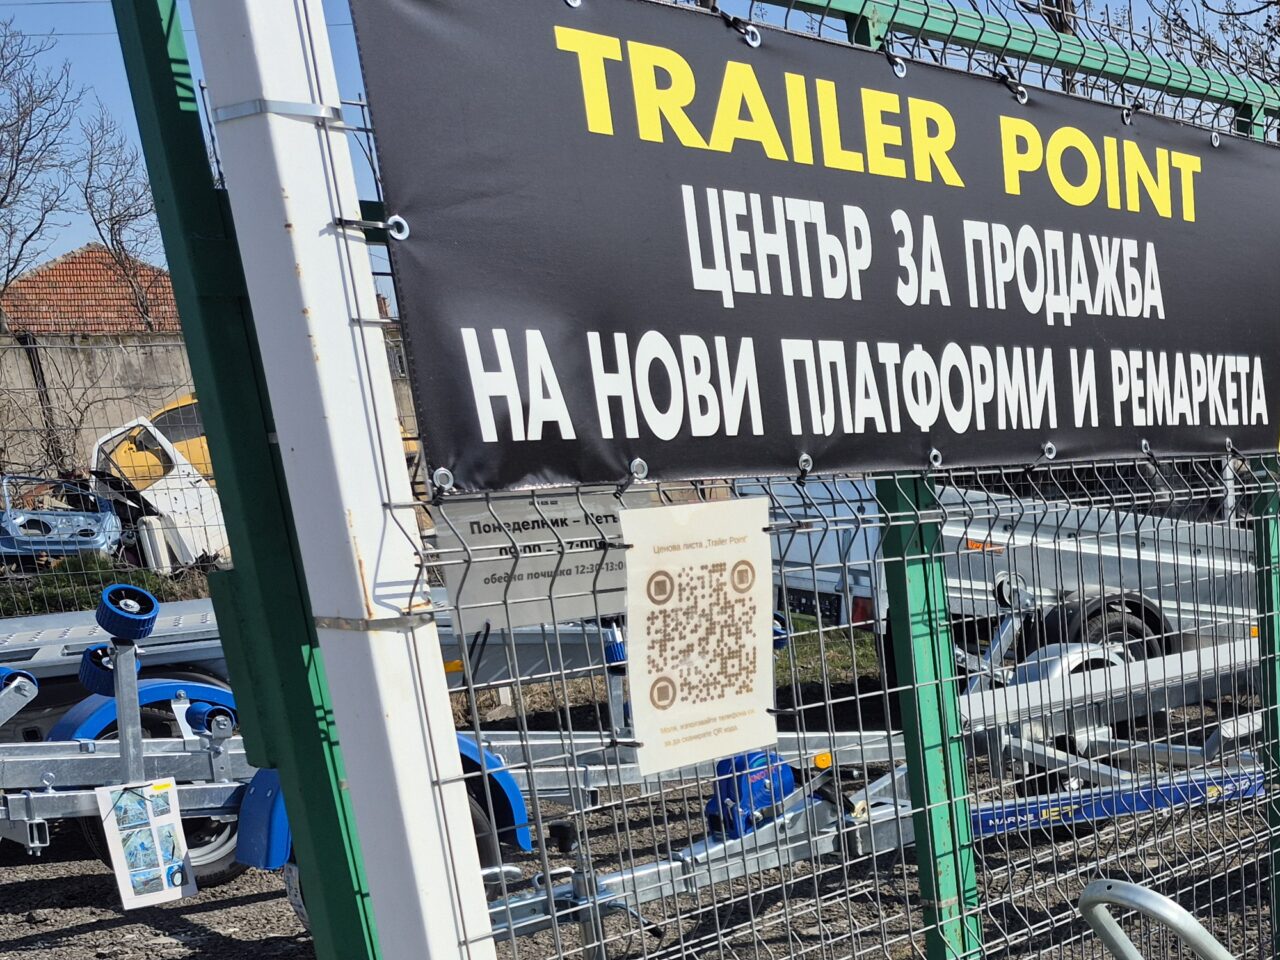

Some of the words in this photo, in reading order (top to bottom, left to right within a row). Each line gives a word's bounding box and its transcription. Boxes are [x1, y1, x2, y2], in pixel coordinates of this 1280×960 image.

[556, 27, 963, 186] TRAILER
[1002, 118, 1202, 222] POINT
[682, 185, 872, 308] ЦЕНТЪР
[891, 209, 950, 307] ЗА
[963, 220, 1166, 326] ПРОДАЖБА
[461, 328, 576, 442] НА
[587, 331, 763, 440] НОВИ
[781, 339, 1057, 437] ПЛАТФОРМИ
[1070, 349, 1098, 427] И
[1111, 350, 1269, 427] РЕМАРКЕТА
[469, 516, 569, 535] Понеделник
[526, 567, 572, 580] почика
[989, 813, 1034, 826] MARNE
